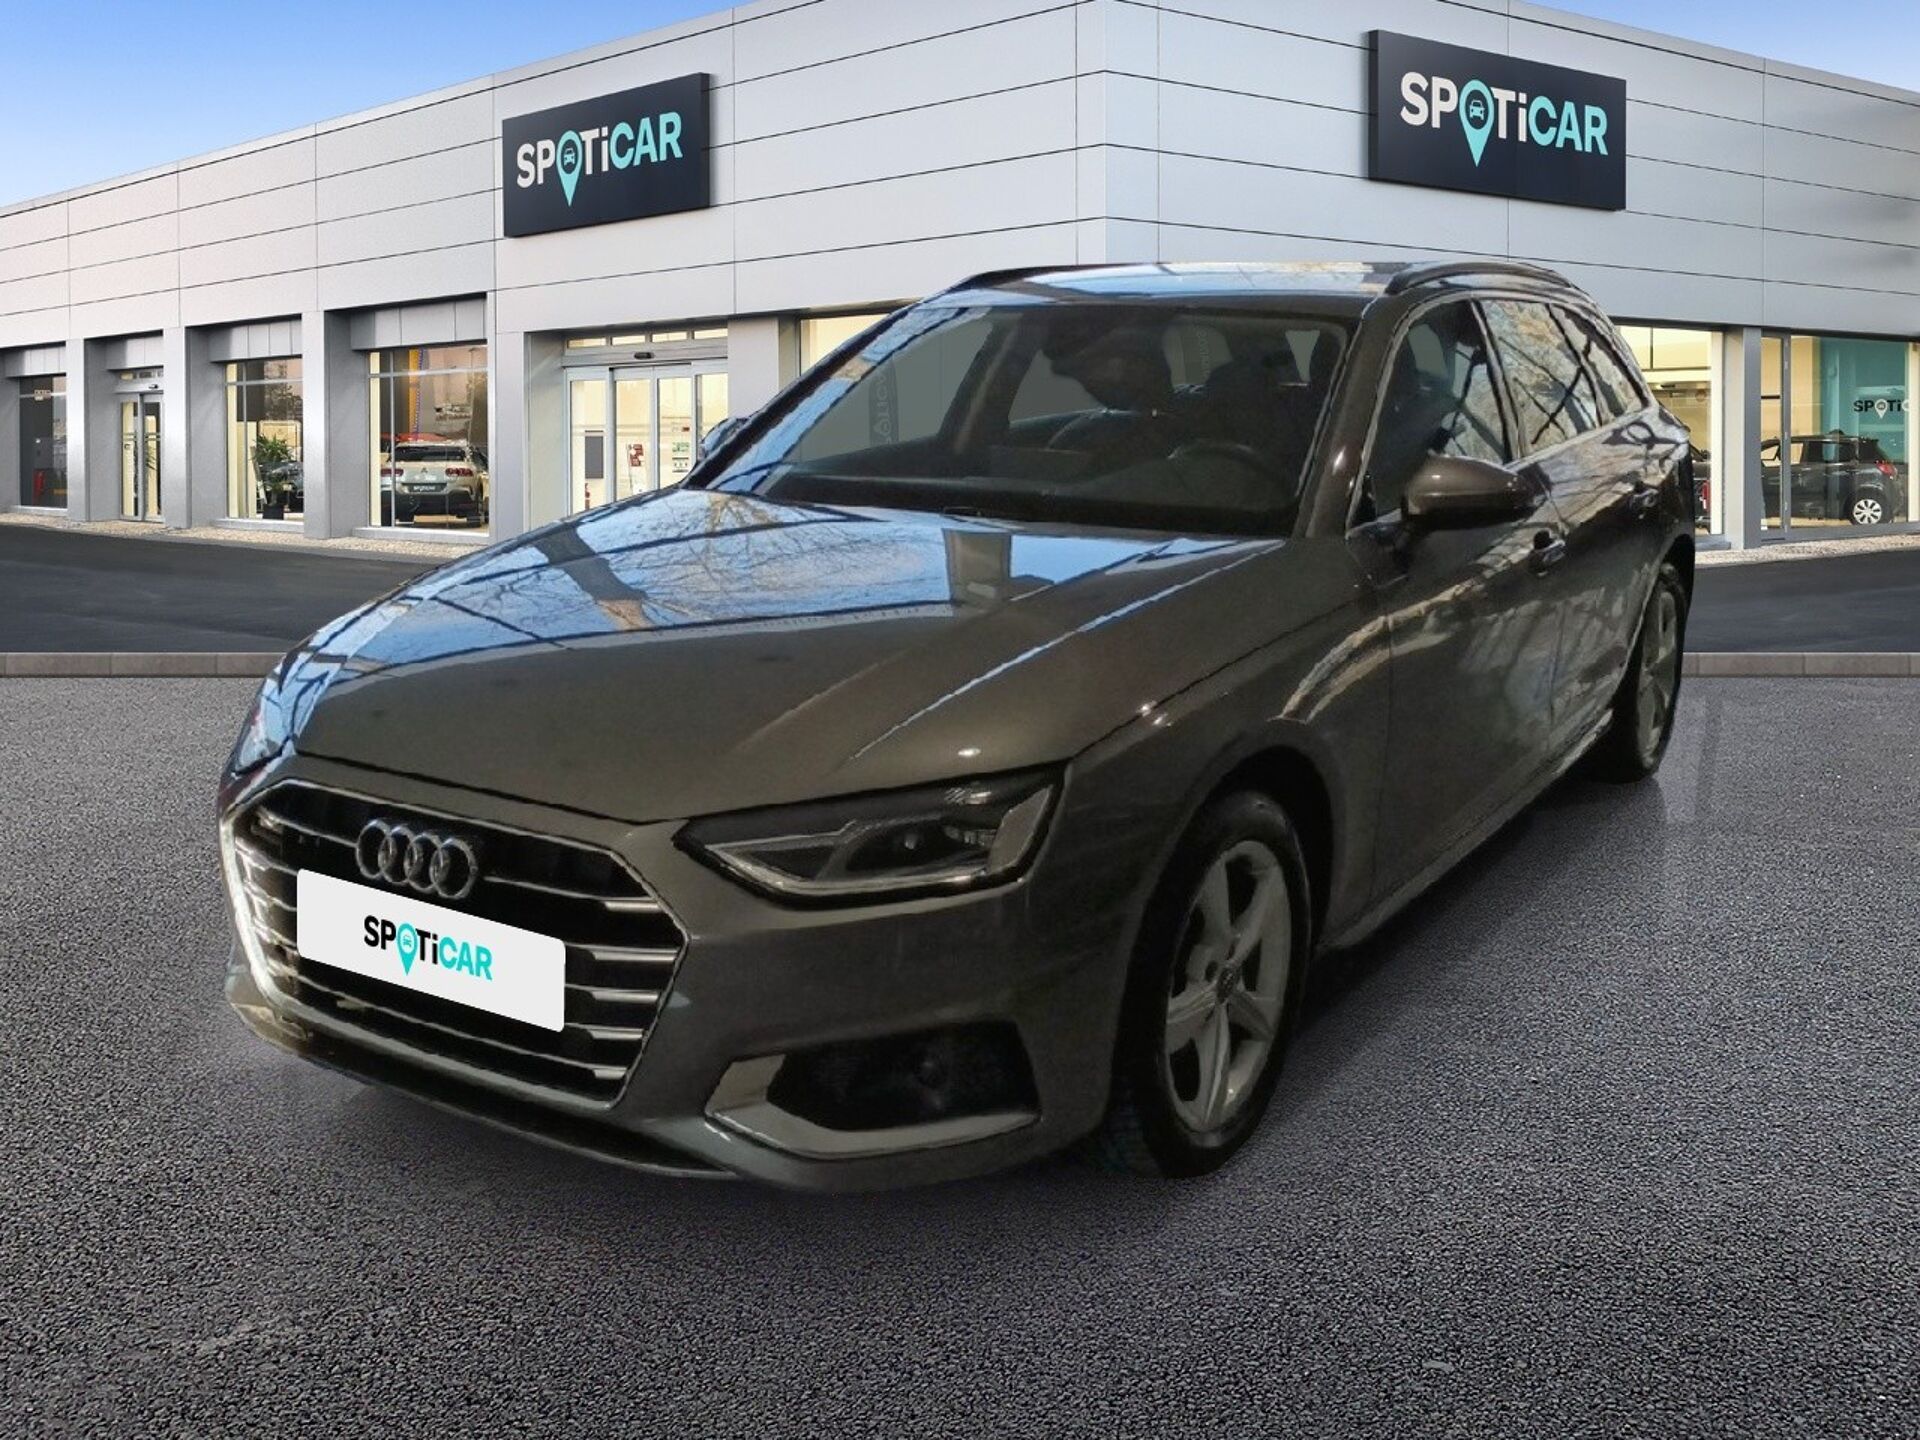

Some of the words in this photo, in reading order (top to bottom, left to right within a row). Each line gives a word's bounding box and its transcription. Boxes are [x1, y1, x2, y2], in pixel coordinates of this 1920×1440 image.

[516, 111, 683, 206] SPOTiCAR
[1400, 71, 1608, 167] SPOTiCAR
[364, 915, 492, 980] SPOTiCAR
